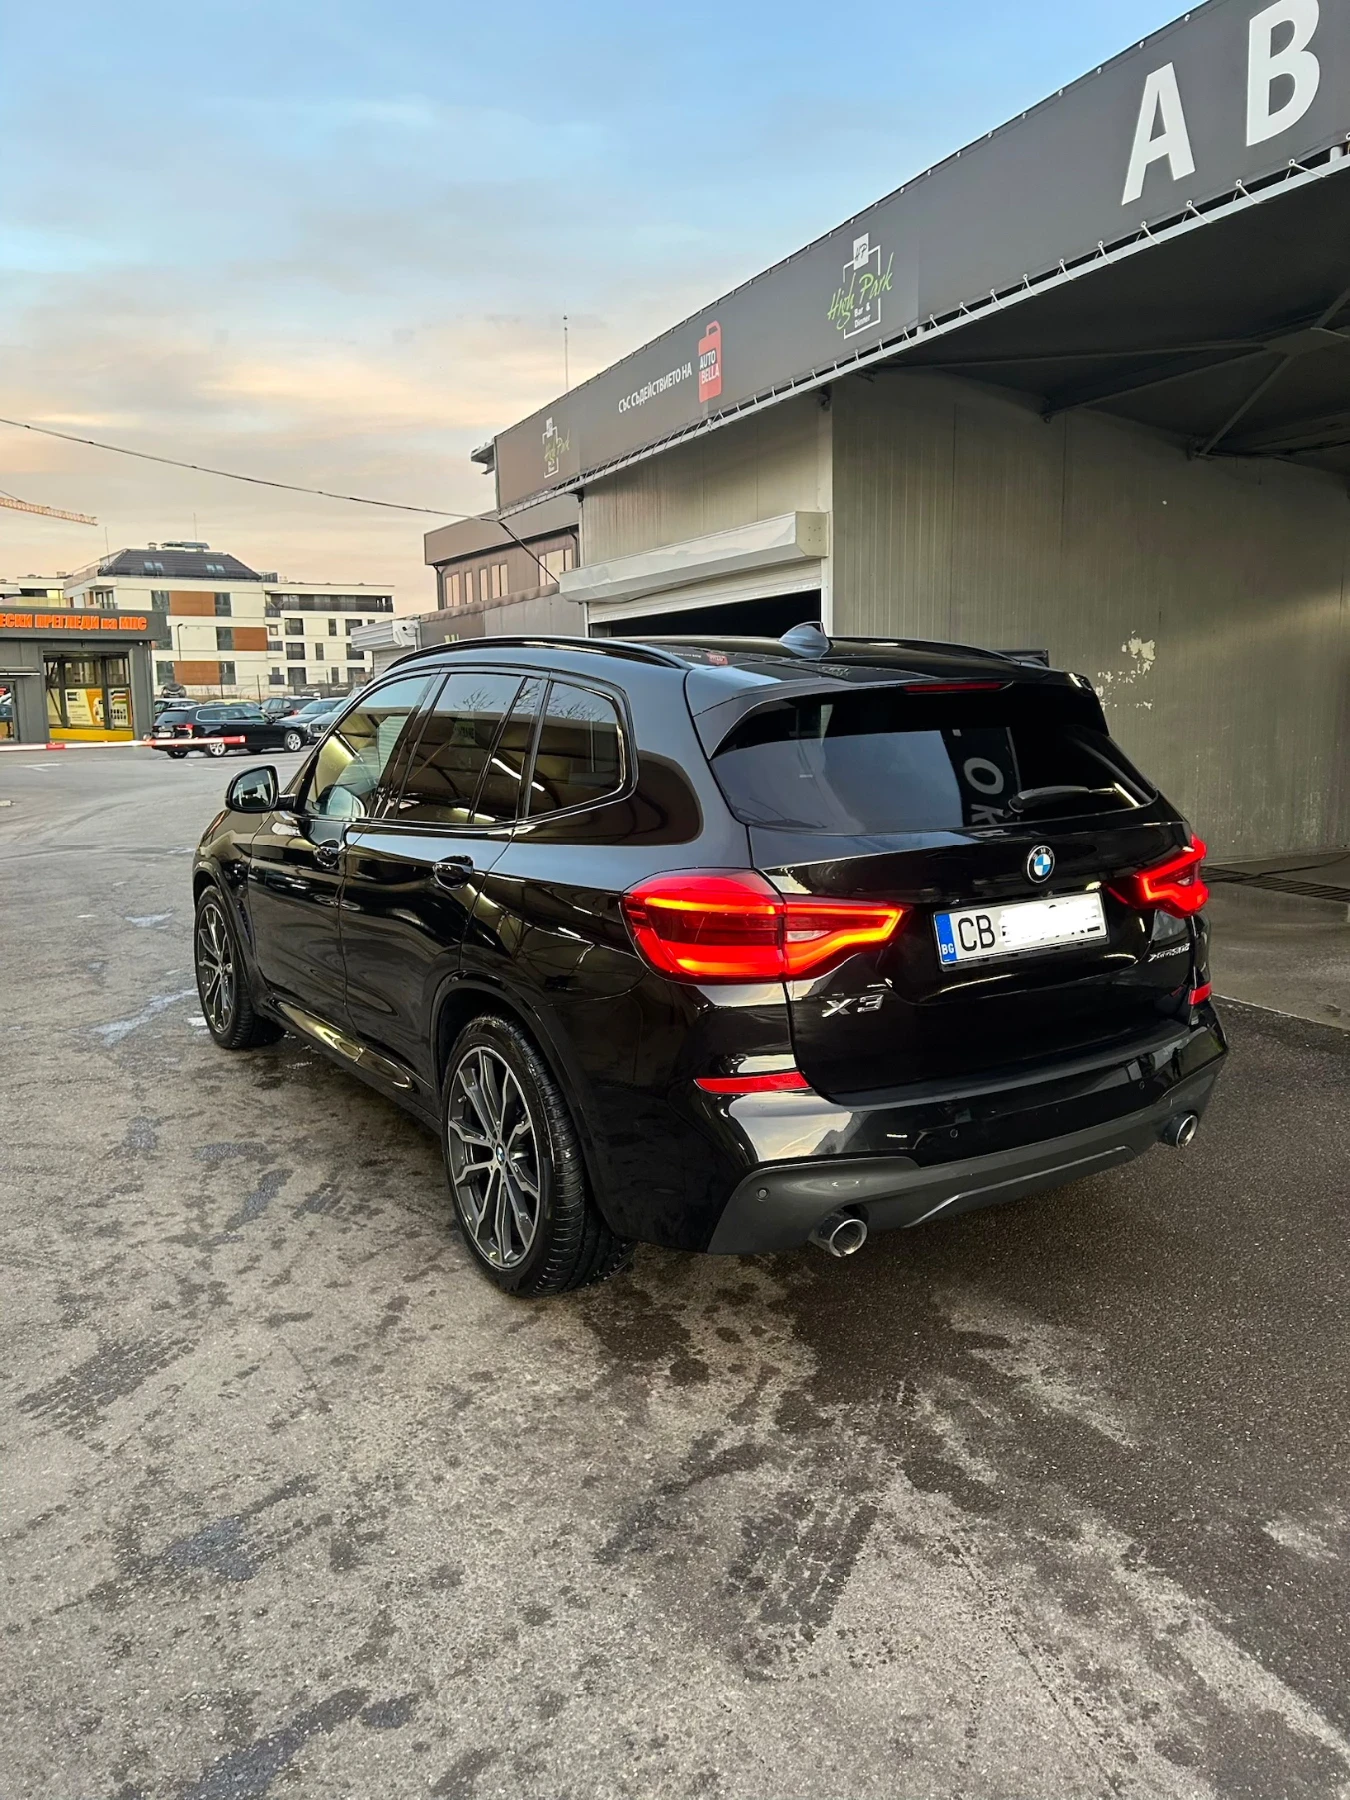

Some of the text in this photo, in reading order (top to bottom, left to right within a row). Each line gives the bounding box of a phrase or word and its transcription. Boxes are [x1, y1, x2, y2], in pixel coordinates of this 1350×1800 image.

[827, 251, 894, 330] High Park
[854, 306, 864, 317] Bar
[854, 314, 872, 329] Dinner
[699, 350, 716, 370] AUTO
[701, 363, 720, 385] BELLA
[618, 362, 692, 413] СЪС СЪДЕЙСТВИЕТО НА
[34, 614, 100, 631] ПРЕГЛЕДИ
[118, 616, 148, 631] МПС
[941, 943, 956, 956] BG
[821, 994, 884, 1018] X3
